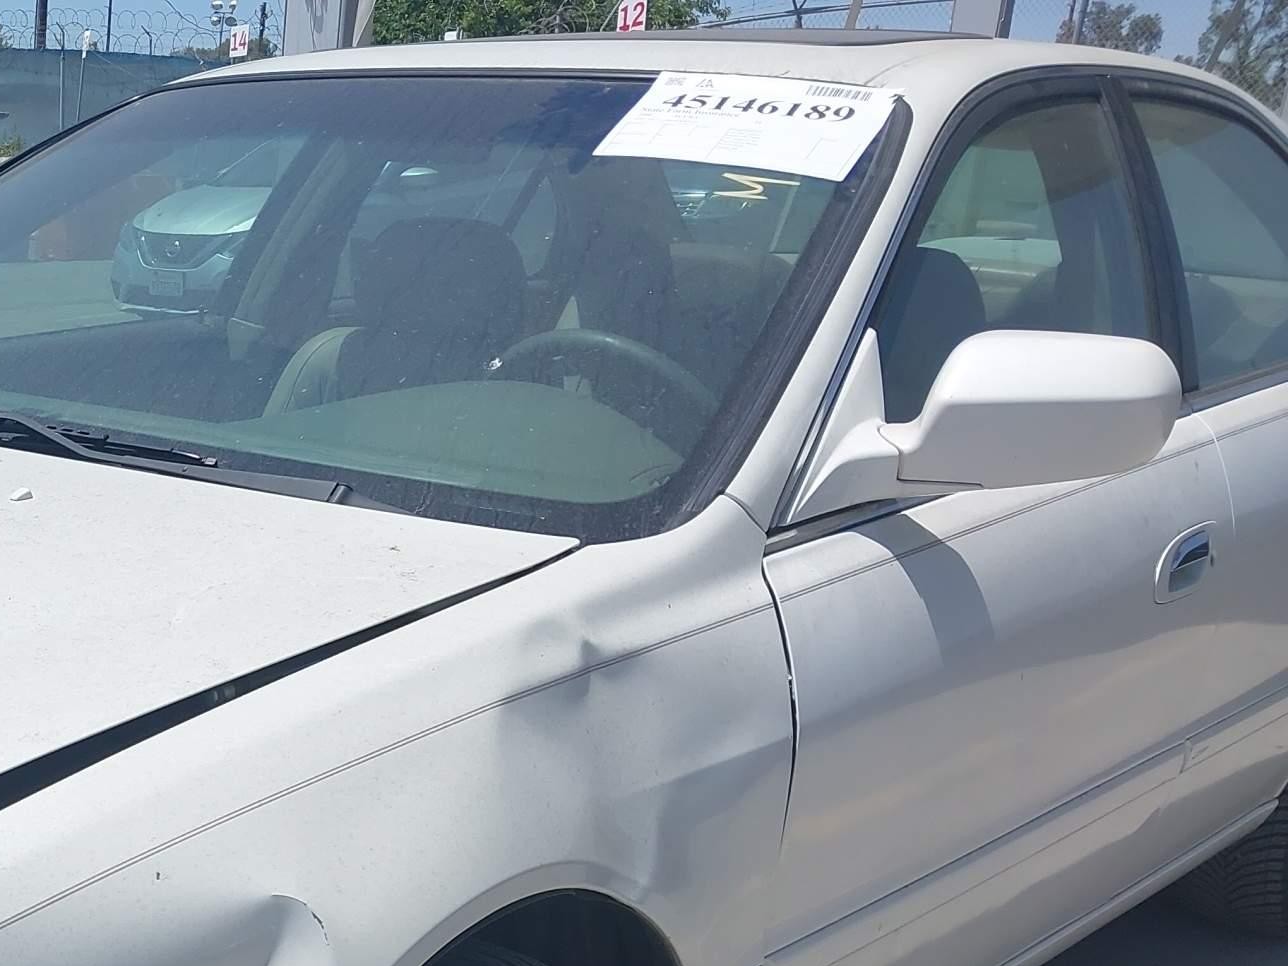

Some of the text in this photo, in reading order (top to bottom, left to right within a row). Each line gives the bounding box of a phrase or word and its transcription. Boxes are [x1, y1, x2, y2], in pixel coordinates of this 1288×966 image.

[619, 2, 645, 31] 12
[230, 31, 248, 51] 14
[662, 93, 856, 122] 45146189
